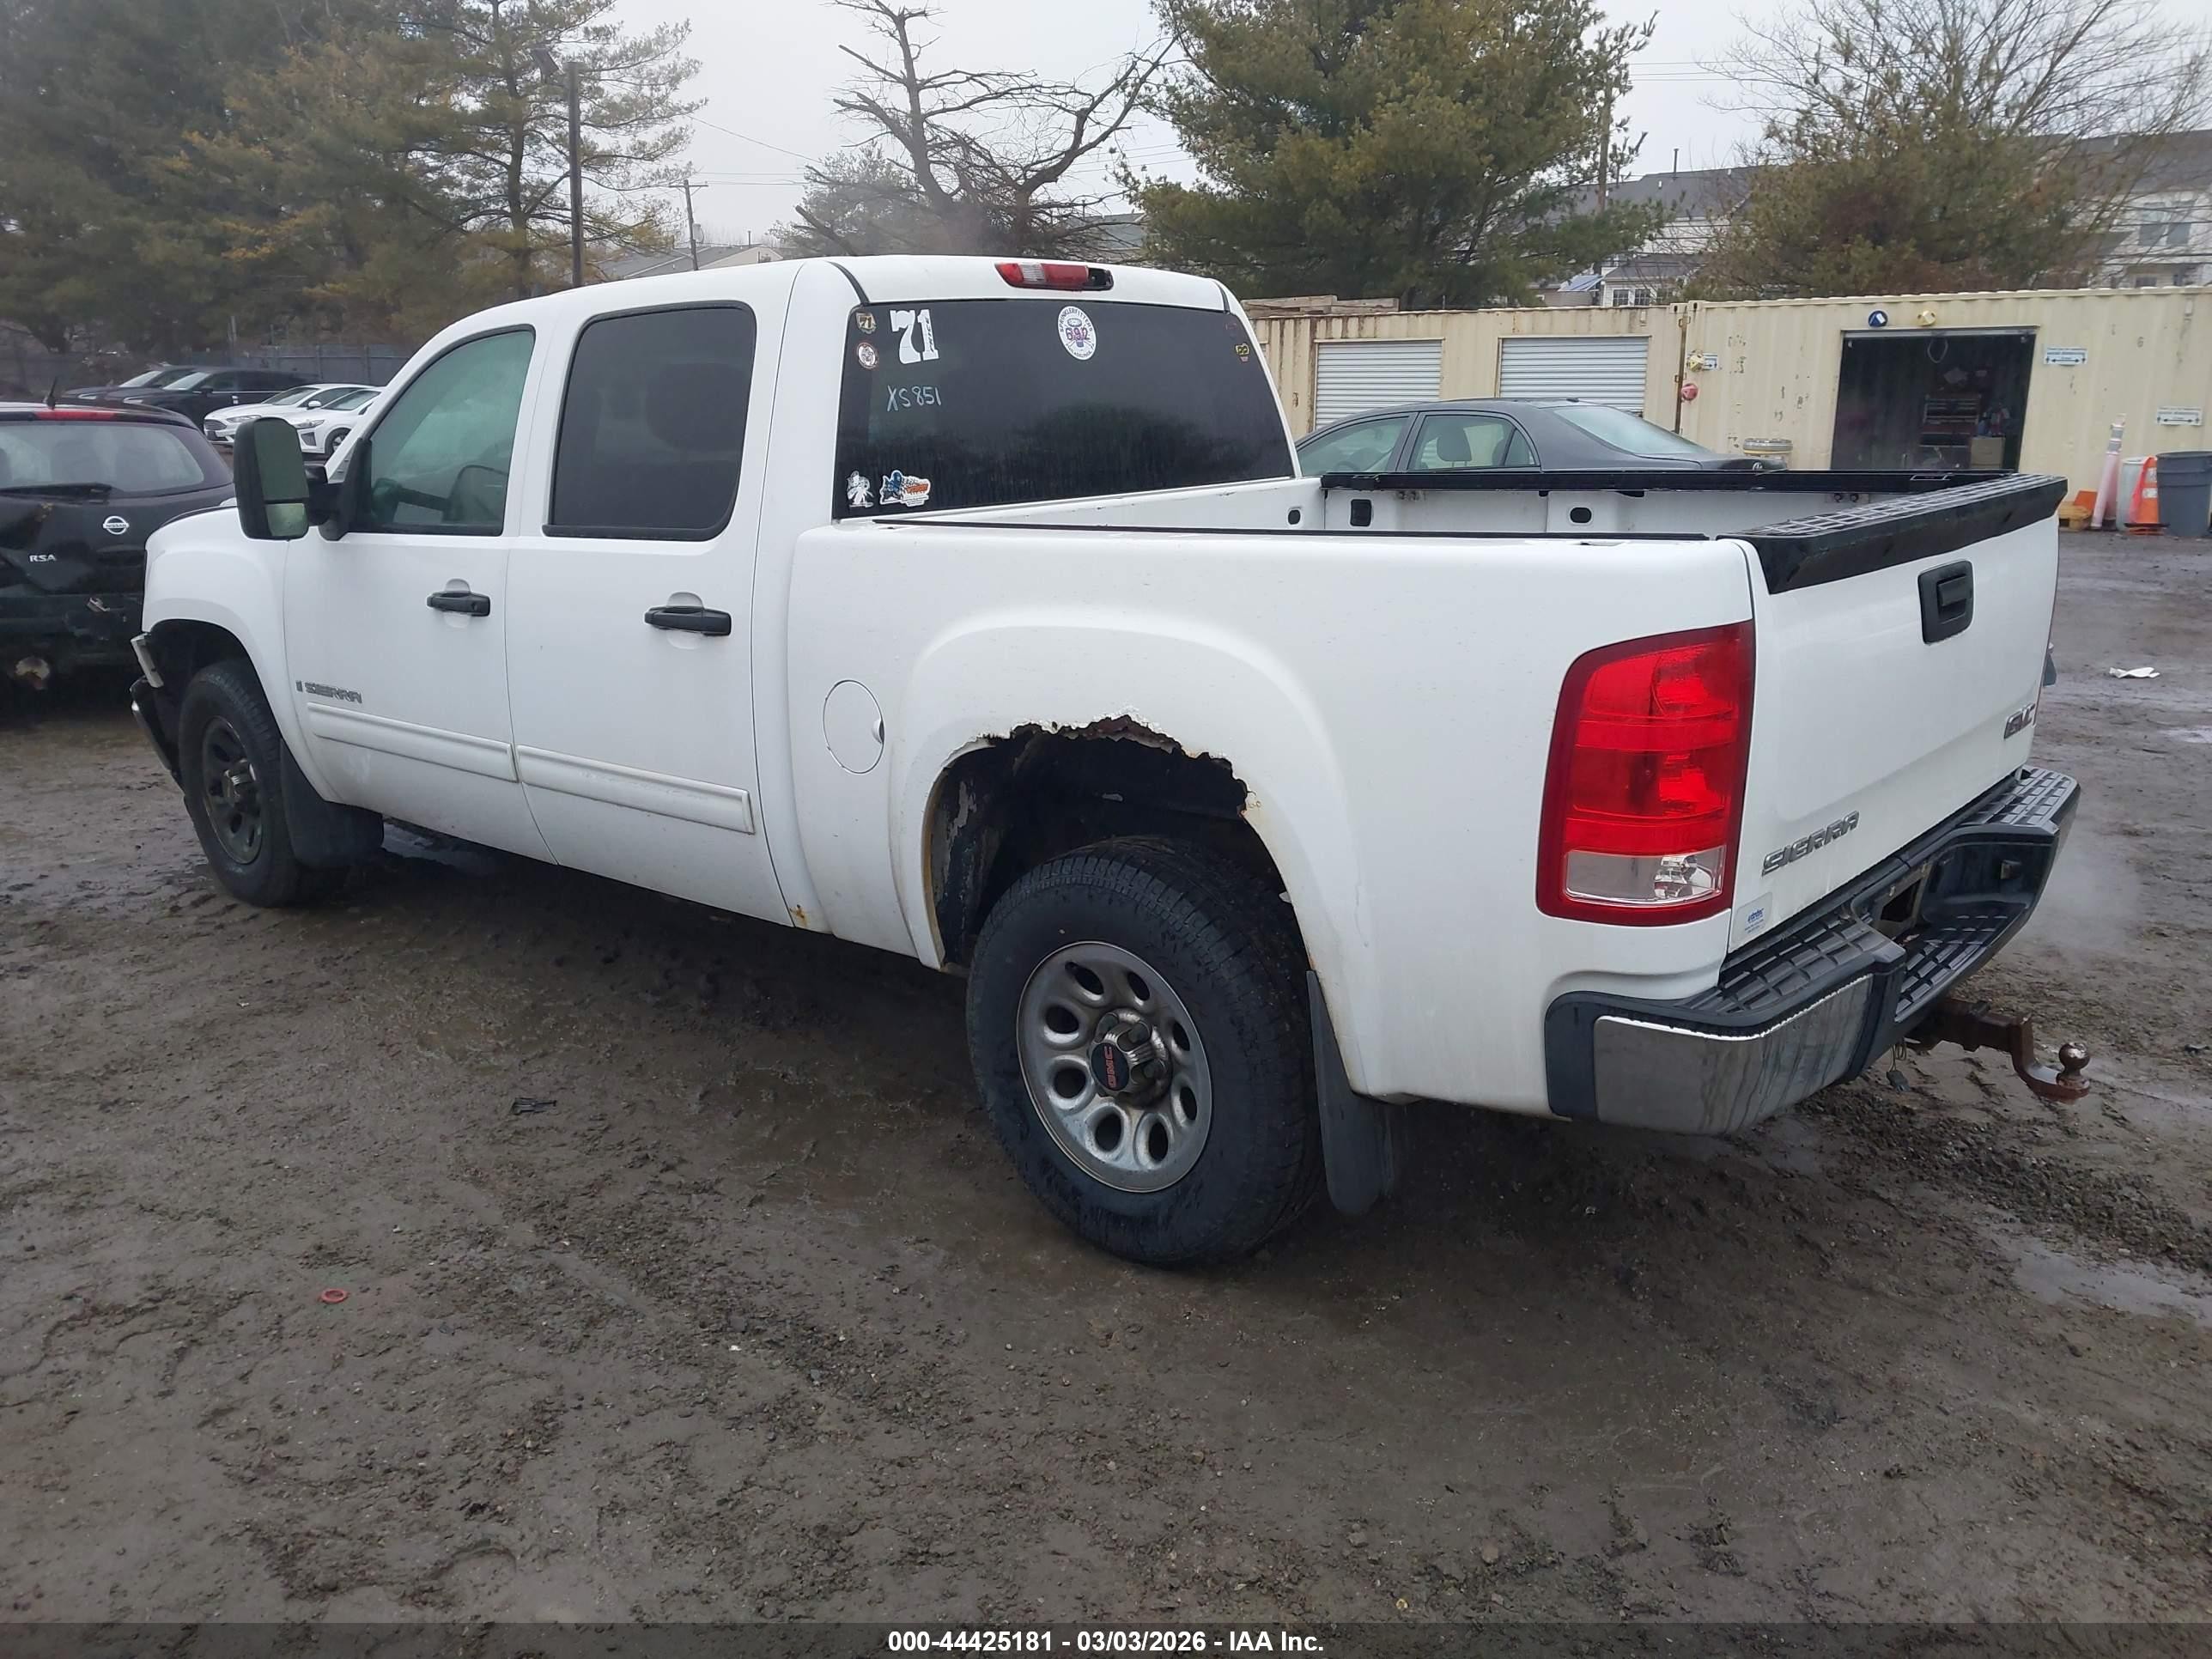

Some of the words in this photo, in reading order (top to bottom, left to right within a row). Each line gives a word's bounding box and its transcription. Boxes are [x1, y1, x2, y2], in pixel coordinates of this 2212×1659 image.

[890, 309, 939, 364] 71
[1066, 327, 1091, 341] 692
[29, 554, 56, 562] RSA
[304, 683, 362, 704] SIERRA
[2003, 703, 2036, 739] GMC
[1761, 811, 1859, 877] SIERRA
[1103, 1045, 1116, 1088] GMC
